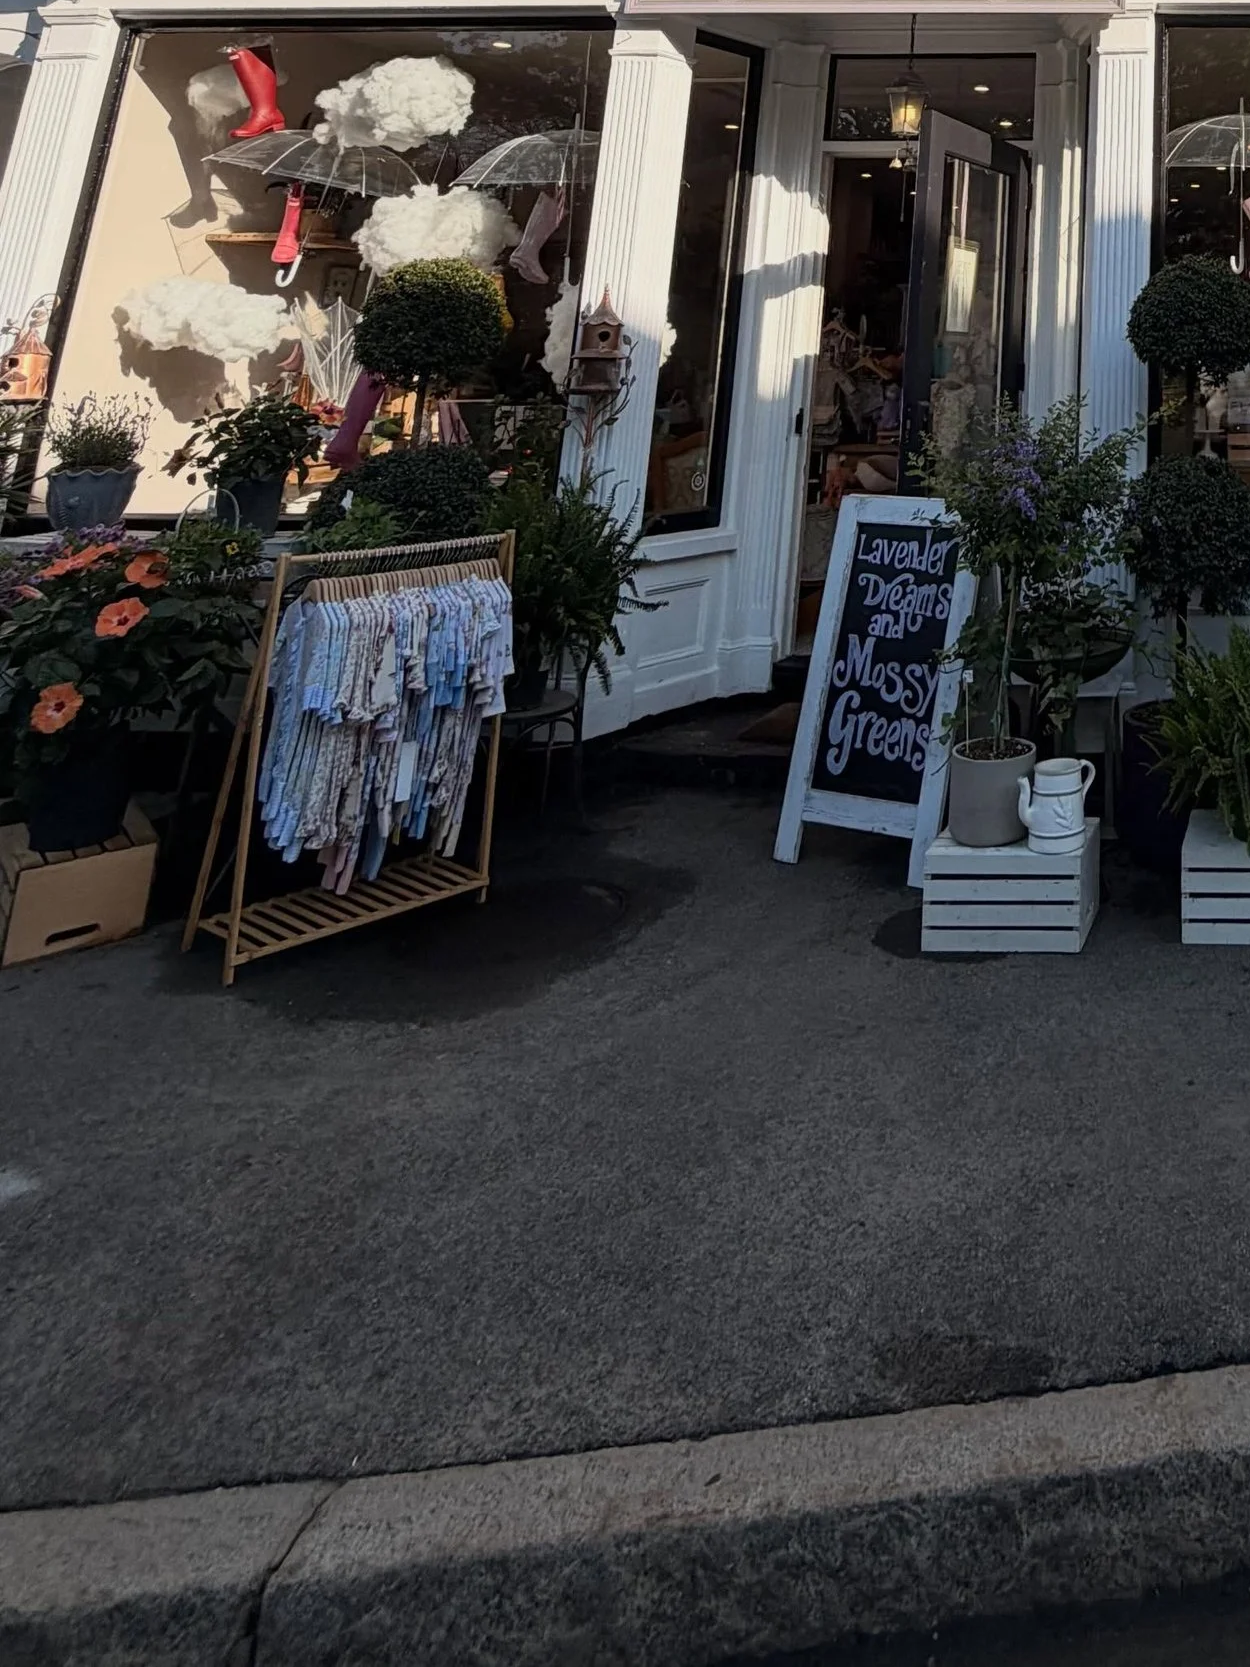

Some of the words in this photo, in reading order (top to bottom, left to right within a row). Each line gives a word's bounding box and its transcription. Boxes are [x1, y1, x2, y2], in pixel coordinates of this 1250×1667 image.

[857, 529, 962, 577] Lavender
[859, 573, 954, 631] Dreams
[868, 610, 904, 639] and
[832, 634, 940, 718] Mossy
[826, 690, 931, 776] Greens
